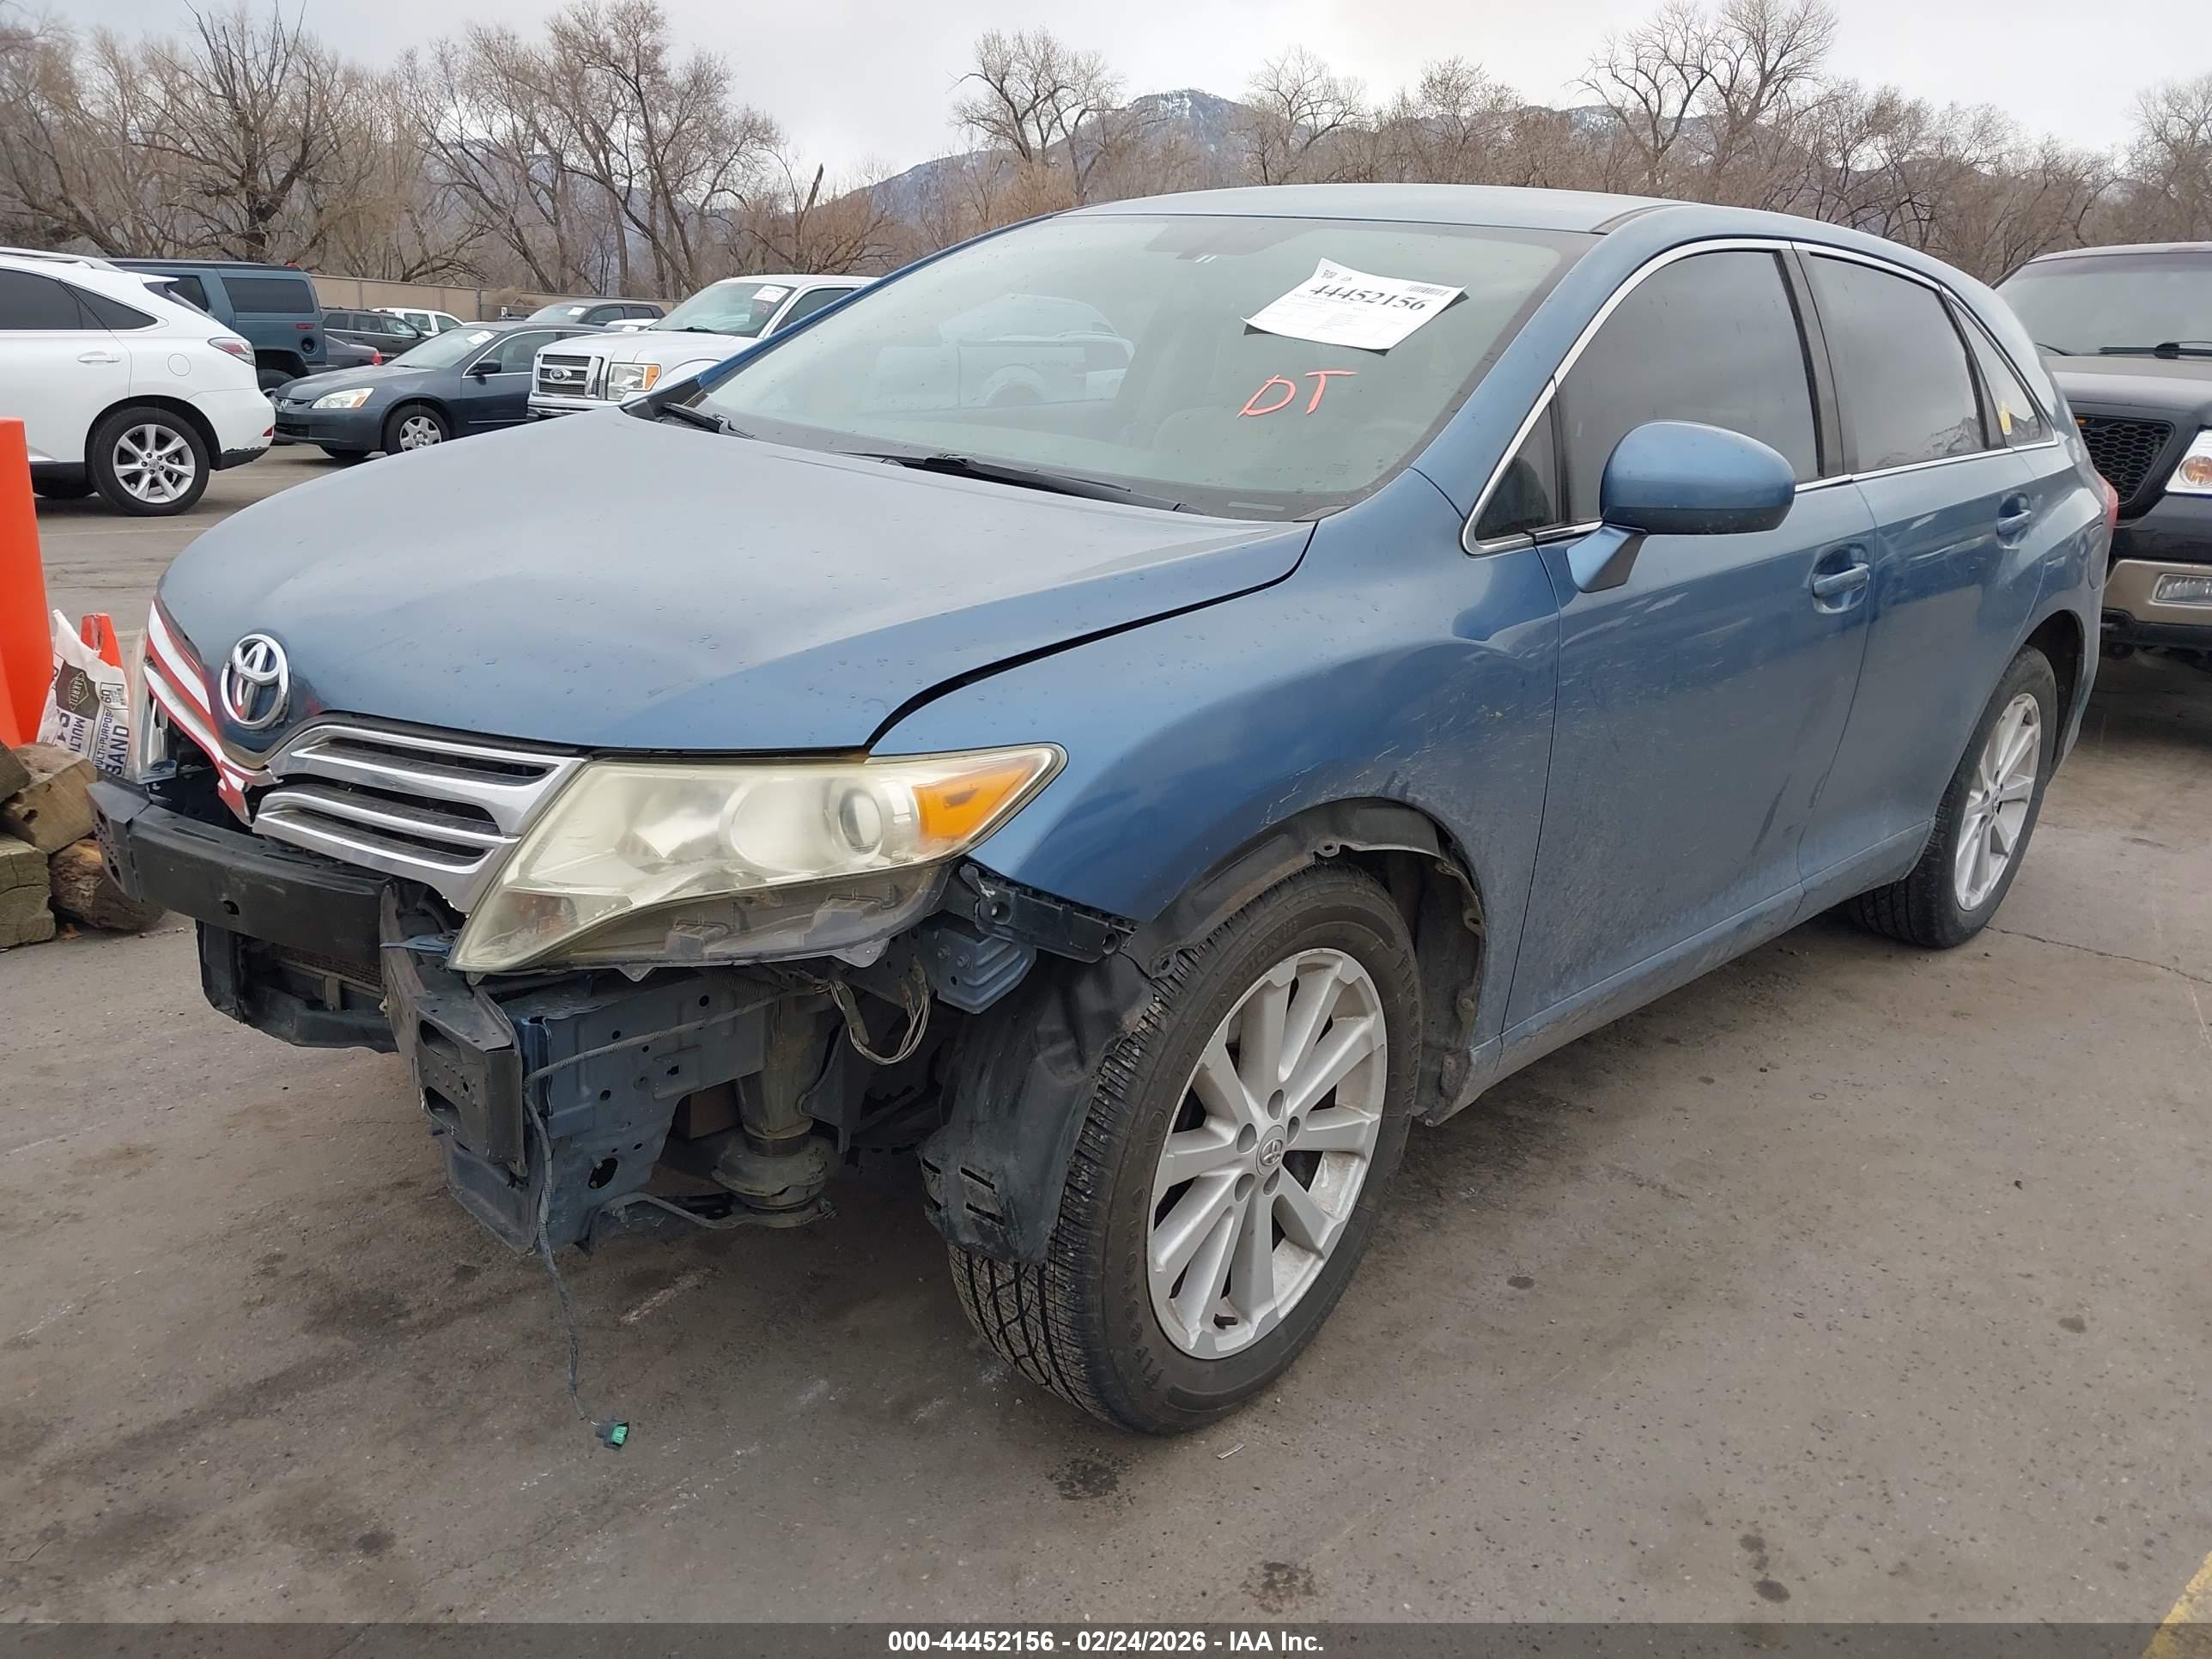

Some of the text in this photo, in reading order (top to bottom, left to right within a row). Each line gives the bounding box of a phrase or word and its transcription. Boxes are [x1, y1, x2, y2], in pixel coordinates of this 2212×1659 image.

[1310, 283, 1428, 312] 44452156
[100, 689, 112, 705] 60
[106, 725, 130, 776] SAND
